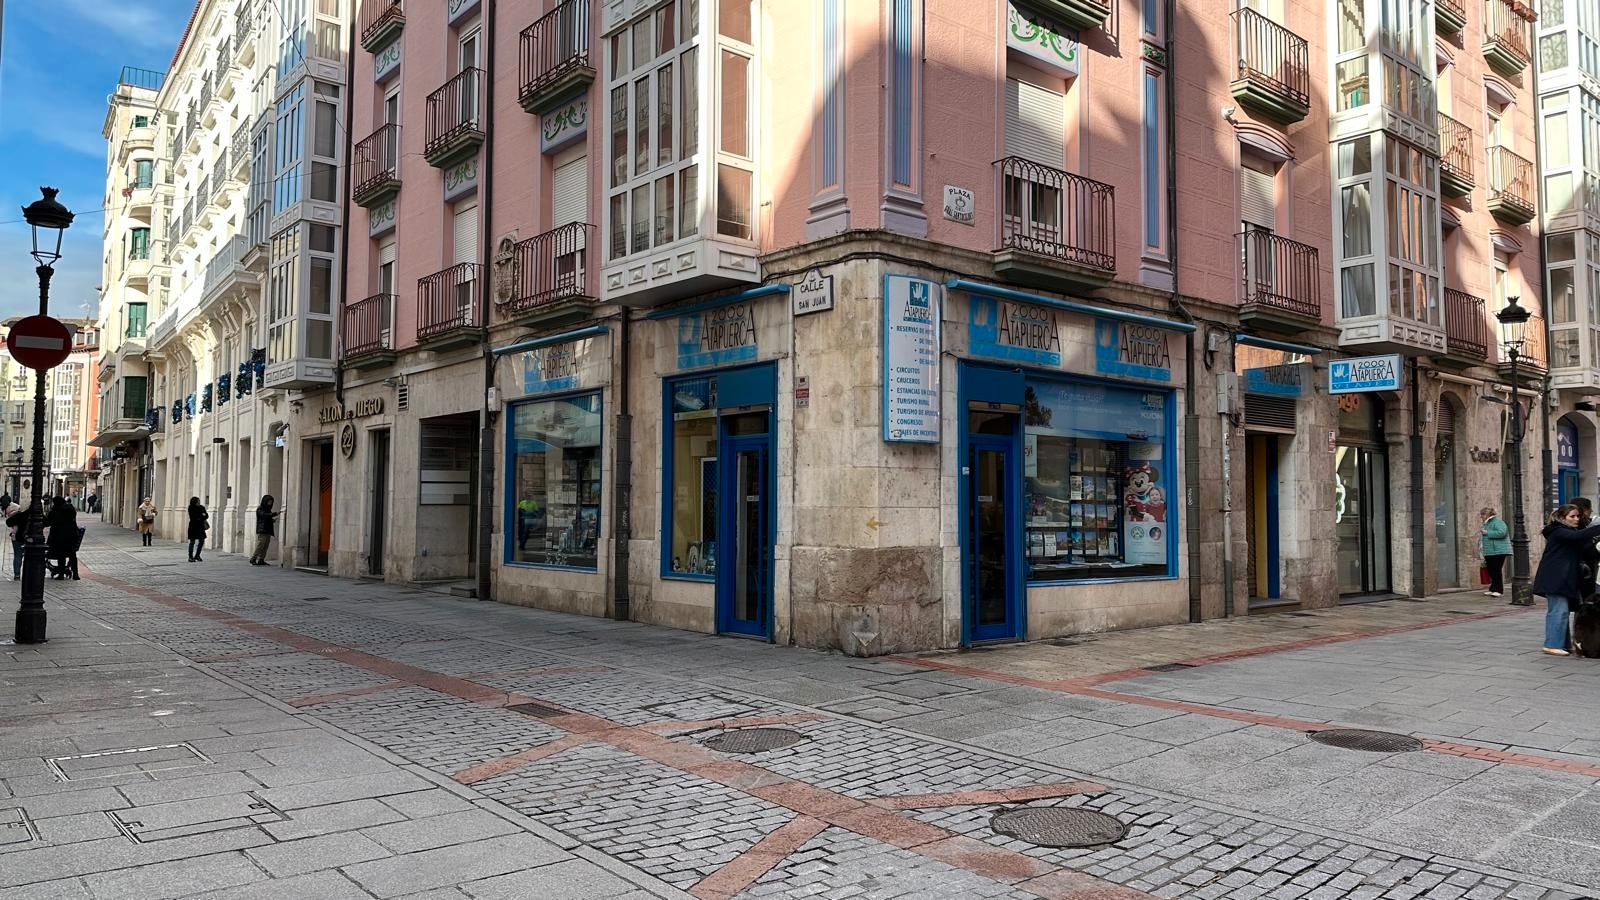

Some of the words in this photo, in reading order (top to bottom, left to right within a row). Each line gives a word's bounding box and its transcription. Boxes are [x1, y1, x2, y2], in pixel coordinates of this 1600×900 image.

[949, 188, 970, 200] PLAZA
[800, 280, 823, 293] CALLE
[799, 300, 809, 309] SAN
[812, 296, 826, 307] JUAN
[712, 304, 744, 322] 2000
[903, 300, 933, 319] ATAPUERCA
[1012, 304, 1048, 321] 2000
[700, 304, 757, 352] ATAPUERCA
[896, 325, 918, 333] RESERVAS
[999, 303, 1061, 353] ATAPUERCA
[1130, 326, 1160, 341] 2000
[1120, 326, 1171, 369] ATAPUERCA
[896, 367, 920, 375] CIRCUITOS
[1350, 360, 1395, 381] ATAPUERCA
[1359, 360, 1385, 369] 2000
[896, 377, 920, 385] CRUCEROS
[1333, 380, 1394, 389] VIAJES
[896, 388, 920, 396] ESTANCIAS
[353, 397, 382, 418] JUEGO
[896, 408, 917, 416] TURISMO
[896, 418, 923, 426] CONGRESOS
[342, 431, 353, 448] 22
